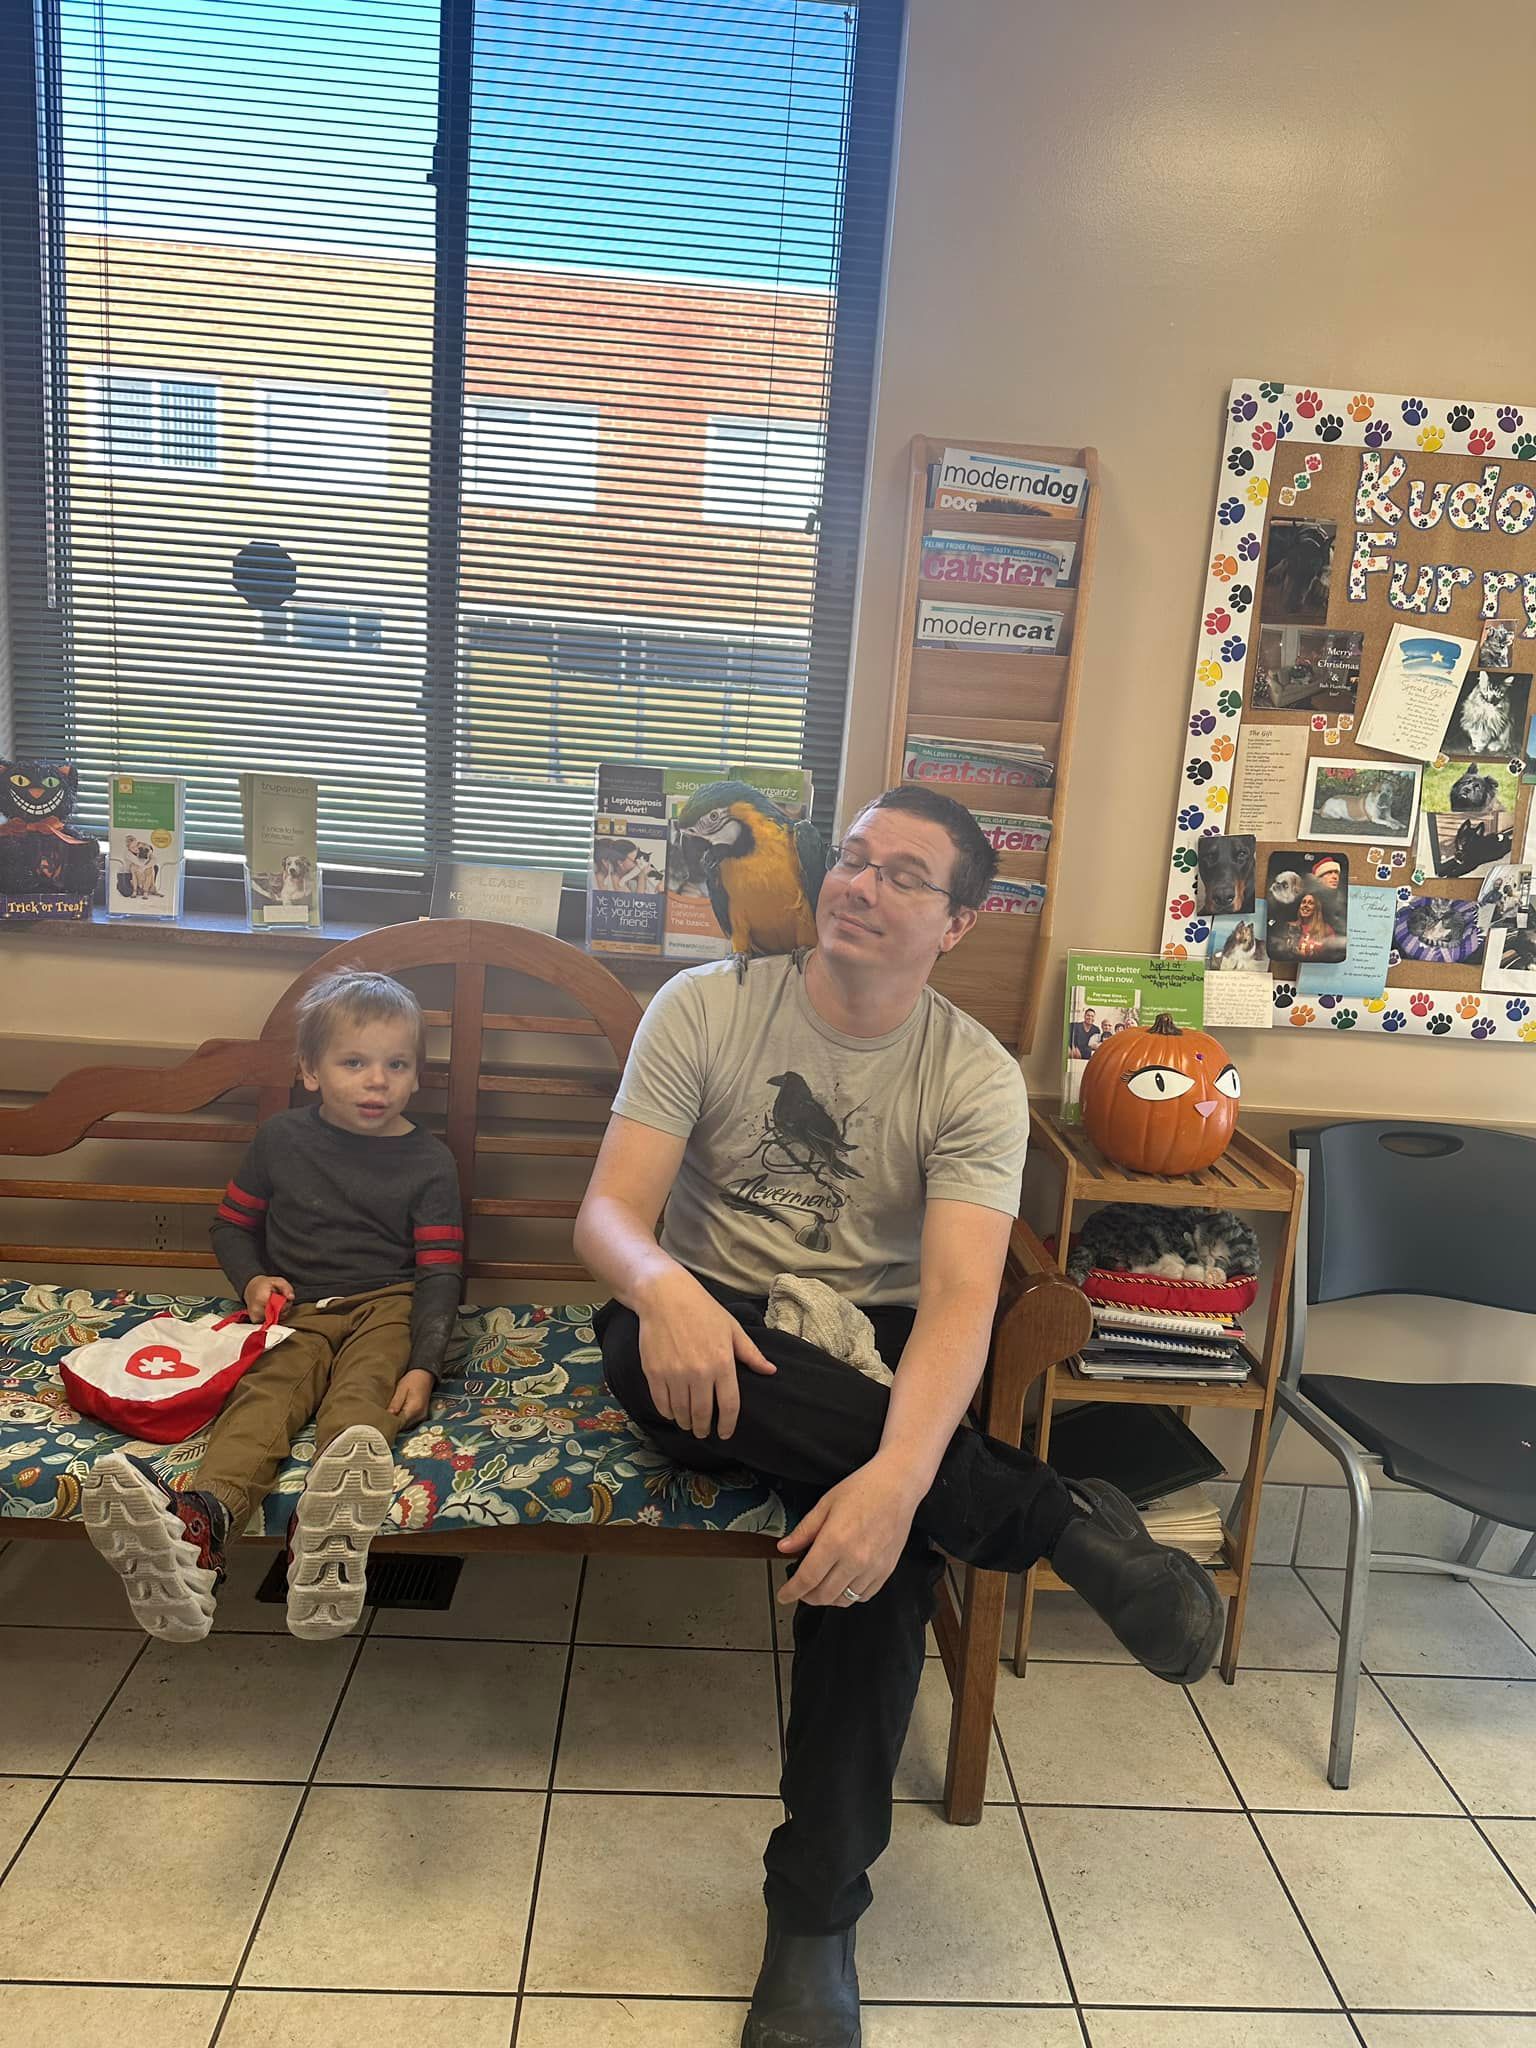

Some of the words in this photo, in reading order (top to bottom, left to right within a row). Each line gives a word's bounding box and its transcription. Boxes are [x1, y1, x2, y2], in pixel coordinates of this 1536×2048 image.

[940, 494, 978, 512] DOG
[924, 554, 1053, 587] catster
[1327, 647, 1353, 659] Merry
[1317, 657, 1360, 670] Christmas
[625, 805, 648, 814] Alert!
[8, 901, 38, 914] Trick
[41, 903, 53, 913] or
[55, 900, 84, 913] Treat
[611, 896, 630, 908] You
[611, 907, 634, 918] your
[634, 908, 659, 919] best
[620, 917, 649, 928] friend
[1077, 963, 1103, 973] There's
[1116, 966, 1141, 974] better
[1077, 974, 1095, 982] time
[1096, 974, 1114, 983] than
[1115, 976, 1135, 984] now.
